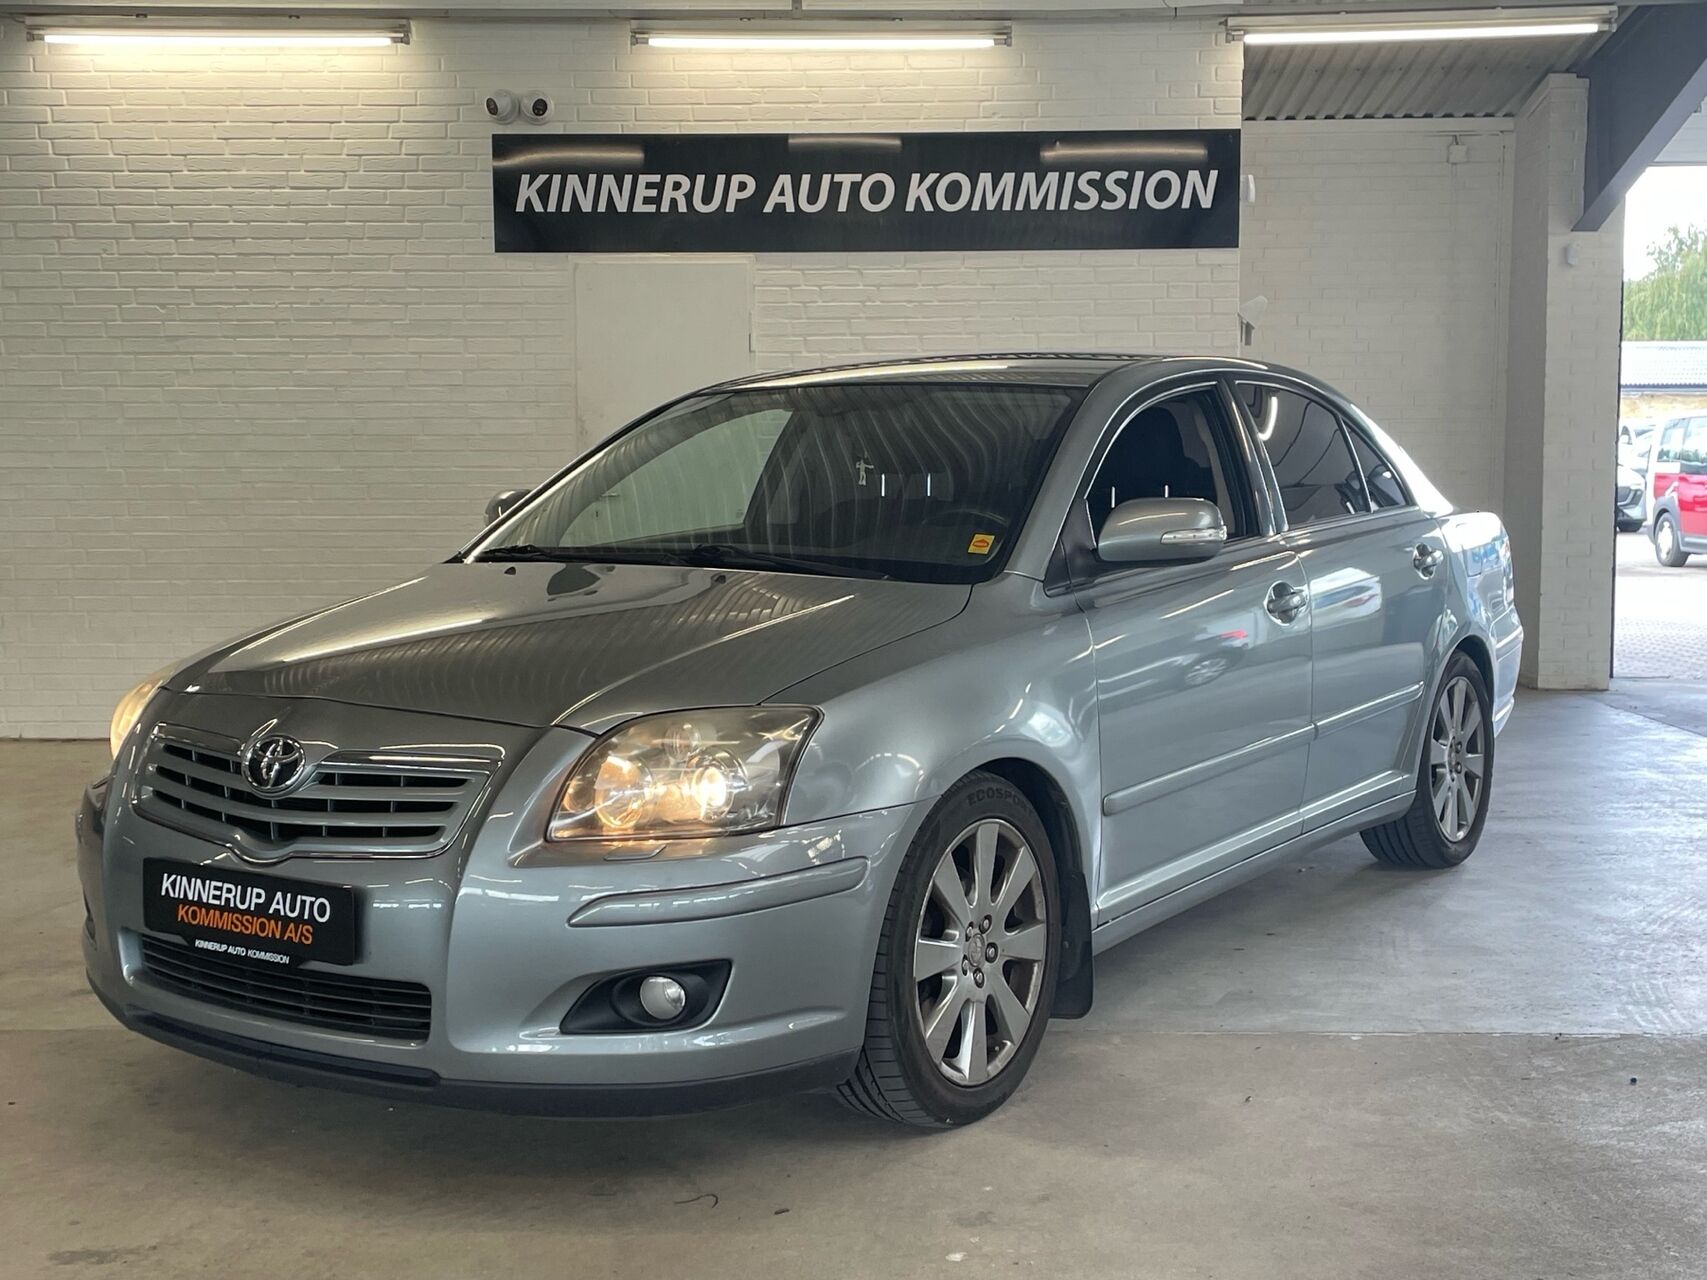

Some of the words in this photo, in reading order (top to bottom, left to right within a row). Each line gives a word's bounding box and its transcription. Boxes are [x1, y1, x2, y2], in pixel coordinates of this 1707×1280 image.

[515, 173, 757, 213] KINNERUP
[763, 172, 895, 213] AUTO
[905, 169, 1219, 212] KOMMISSION
[161, 873, 265, 911] KINNERUP
[269, 891, 331, 922] AUTO
[177, 904, 281, 939] KOMMISSION
[284, 924, 313, 945] A/S
[194, 938, 228, 953] KINNERUP
[228, 945, 246, 956] AUTO
[247, 948, 290, 964] KOMMISSION
